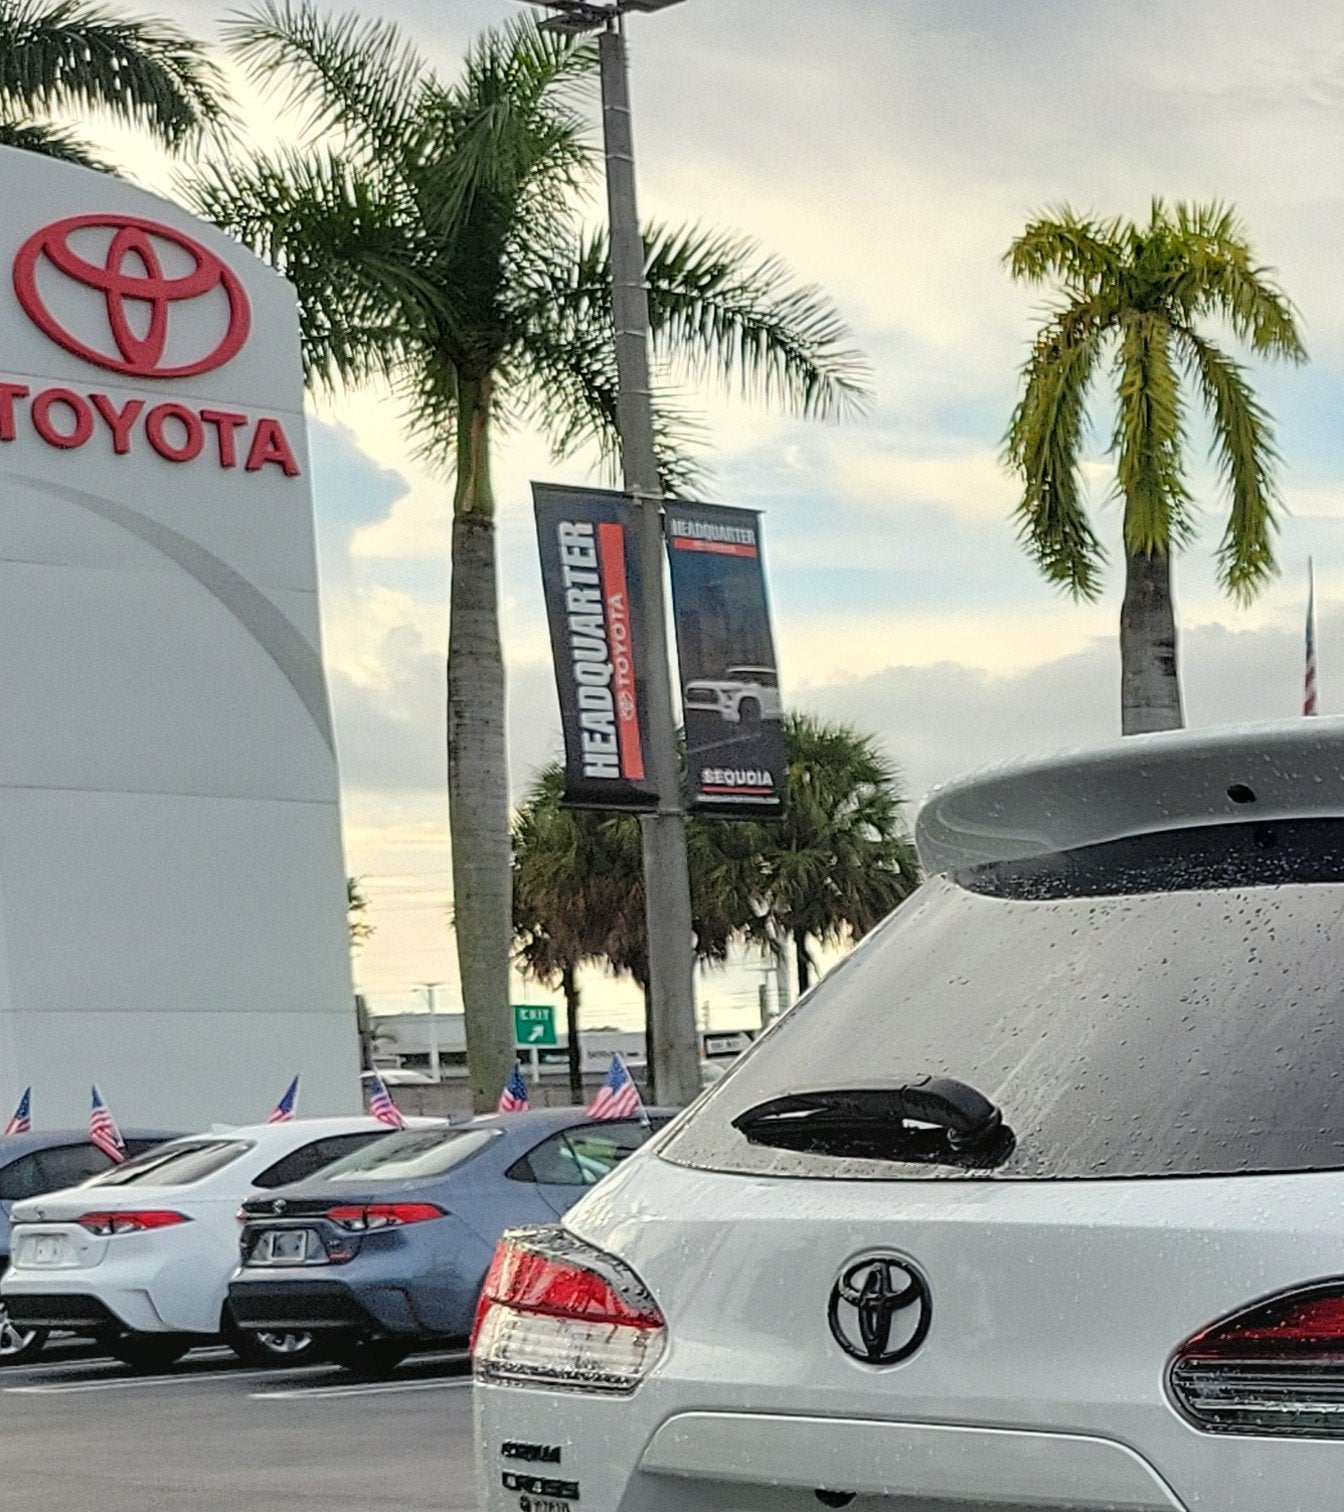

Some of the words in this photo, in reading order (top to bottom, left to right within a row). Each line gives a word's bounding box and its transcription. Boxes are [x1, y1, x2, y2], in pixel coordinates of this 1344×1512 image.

[0, 382, 300, 477] TOYOTA
[558, 520, 620, 779] HEADQUARTER
[608, 592, 632, 687] TOYOTA
[702, 767, 774, 786] SEQUOIA
